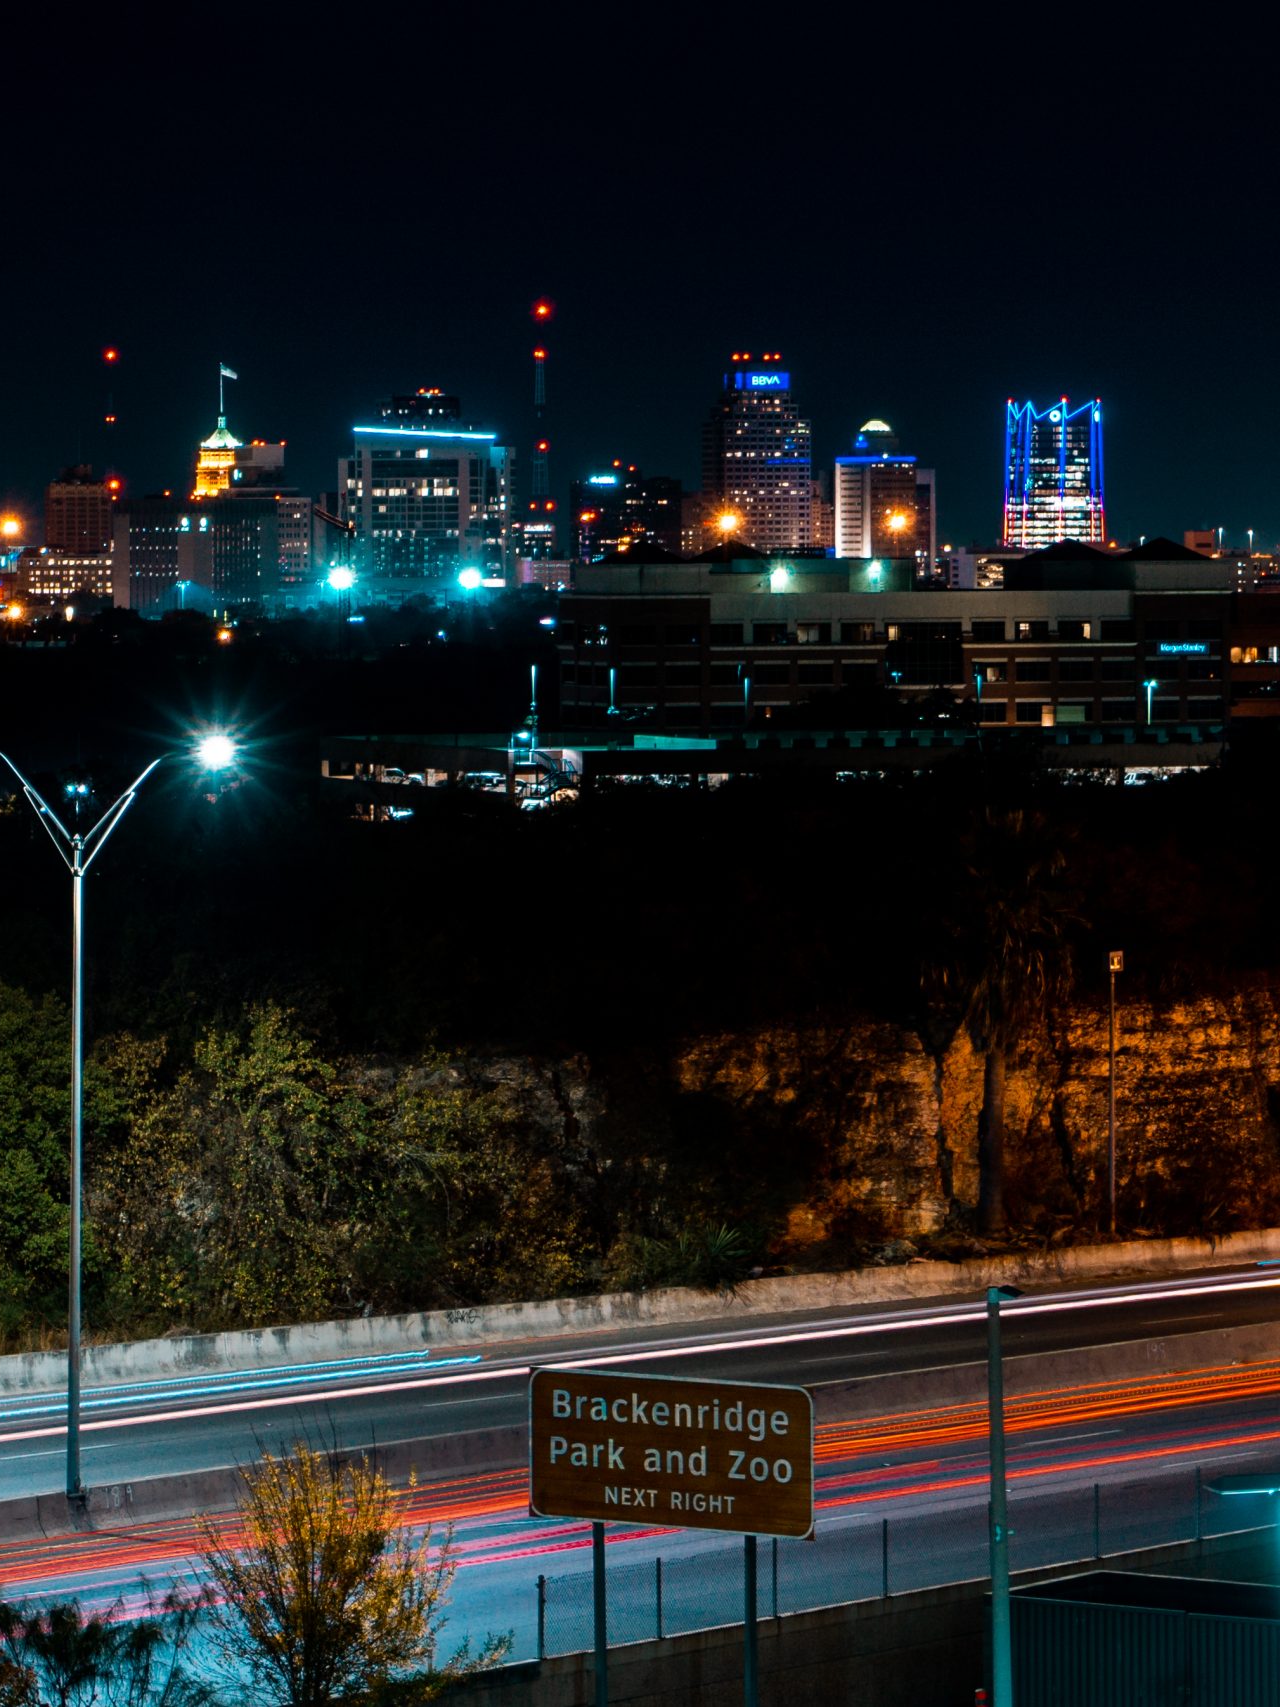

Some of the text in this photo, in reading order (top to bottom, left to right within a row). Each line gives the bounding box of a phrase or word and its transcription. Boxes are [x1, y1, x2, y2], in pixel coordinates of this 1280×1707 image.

[751, 375, 781, 386] BBVA
[552, 1389, 789, 1442] Brackenridge
[549, 1436, 793, 1484] Park and Zoo
[604, 1486, 735, 1514] NEXT RIGHT
